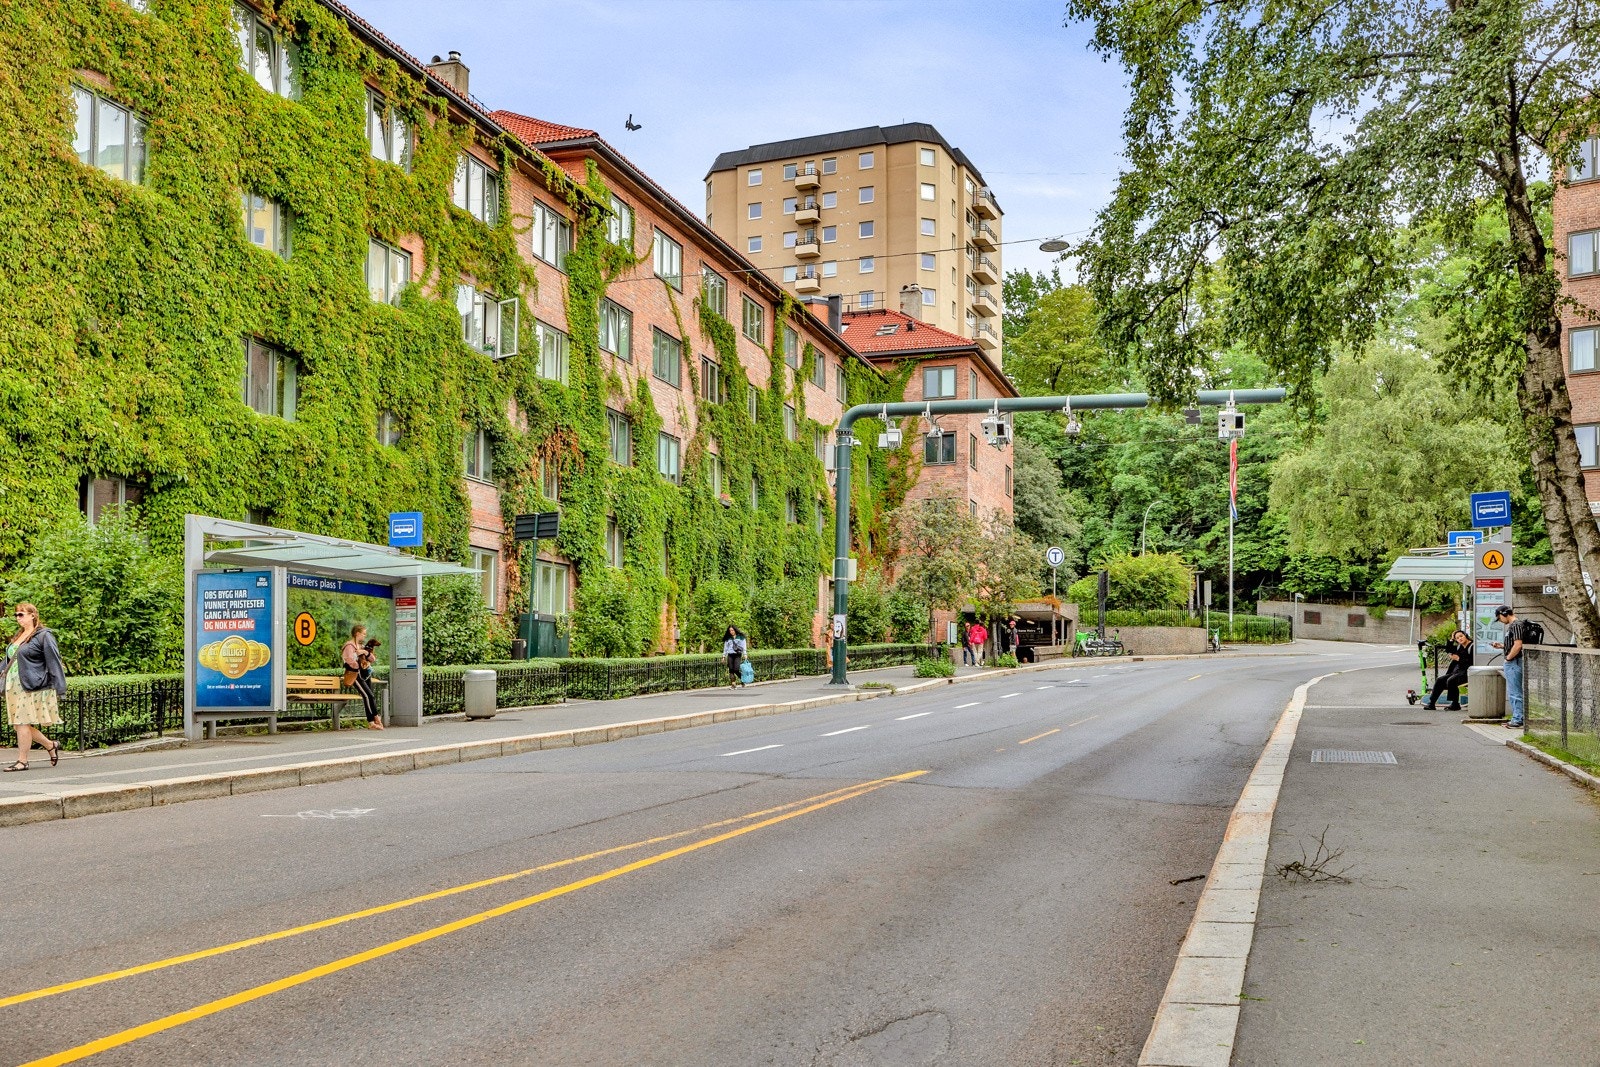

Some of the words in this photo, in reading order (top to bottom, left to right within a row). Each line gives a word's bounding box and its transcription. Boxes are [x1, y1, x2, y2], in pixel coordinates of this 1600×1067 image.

[1488, 554, 1499, 566] A
[292, 575, 318, 587] Berners
[319, 579, 336, 590] plass
[337, 580, 343, 590] T
[204, 590, 217, 600] OBS
[218, 590, 234, 599] BYGG
[234, 590, 248, 598] HAR
[204, 600, 228, 610] VUNNET
[229, 600, 265, 608] PRISTESTER
[204, 611, 222, 620] GANG
[222, 609, 231, 619] PÅ
[231, 610, 248, 619] GANG
[204, 621, 214, 630] OG
[214, 621, 228, 630] NOK
[228, 620, 237, 629] EN
[237, 620, 255, 629] GANG
[301, 619, 311, 638] B
[222, 648, 247, 657] BILLIGST
